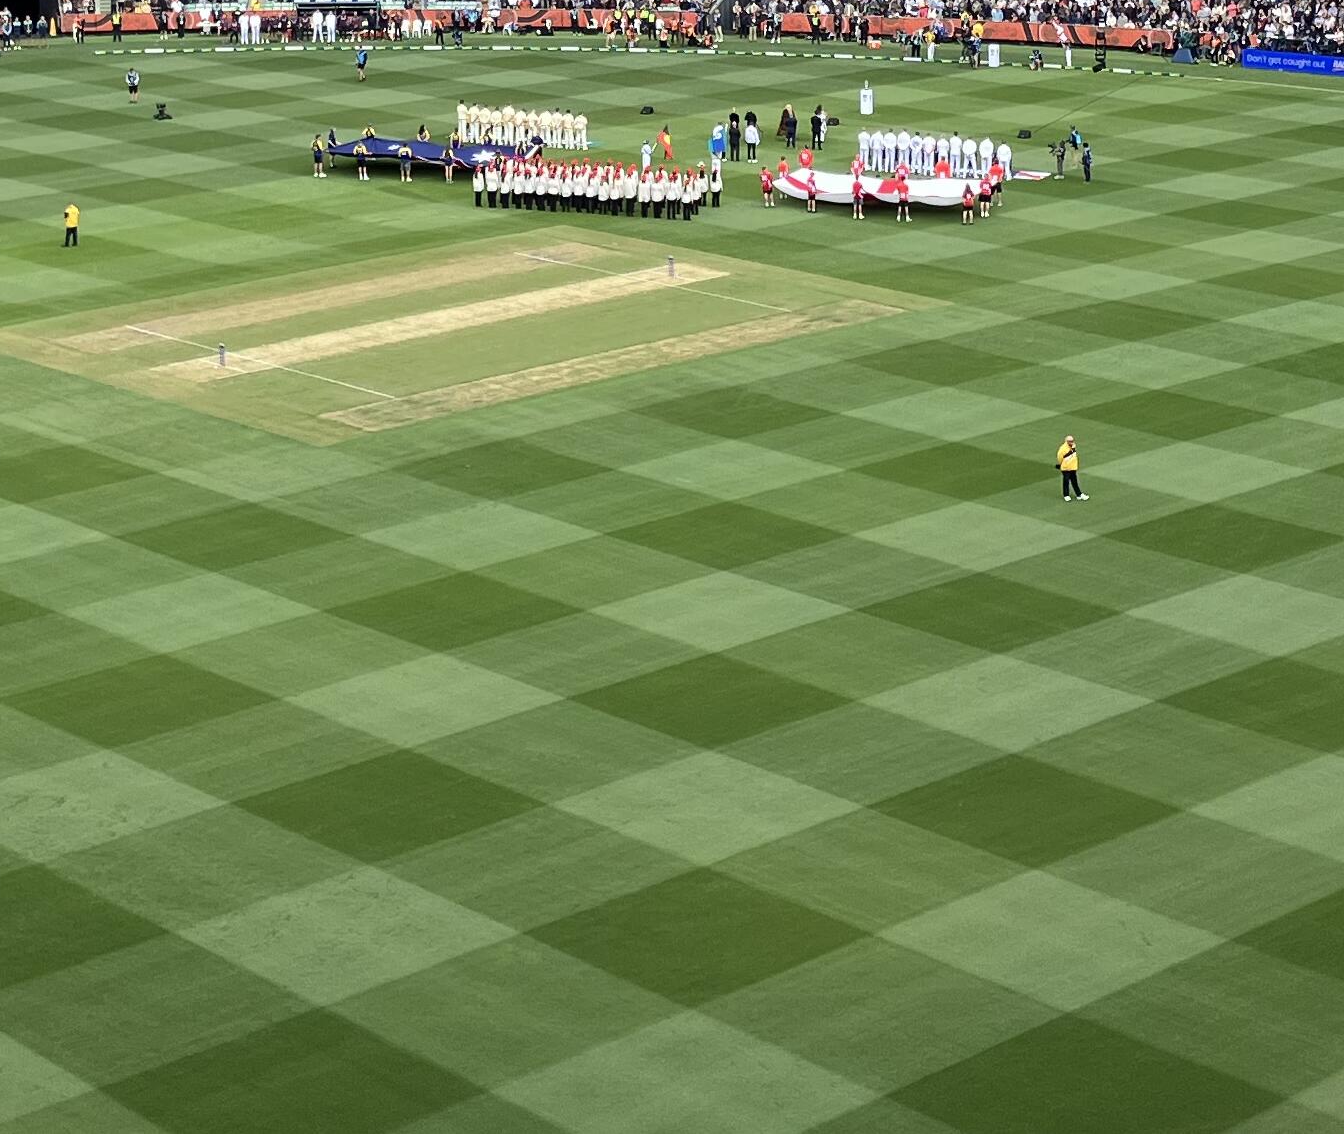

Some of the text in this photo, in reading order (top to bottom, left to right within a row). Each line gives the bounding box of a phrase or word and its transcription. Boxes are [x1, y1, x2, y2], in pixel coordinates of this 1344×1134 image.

[1246, 54, 1326, 69] Don't get caught out
